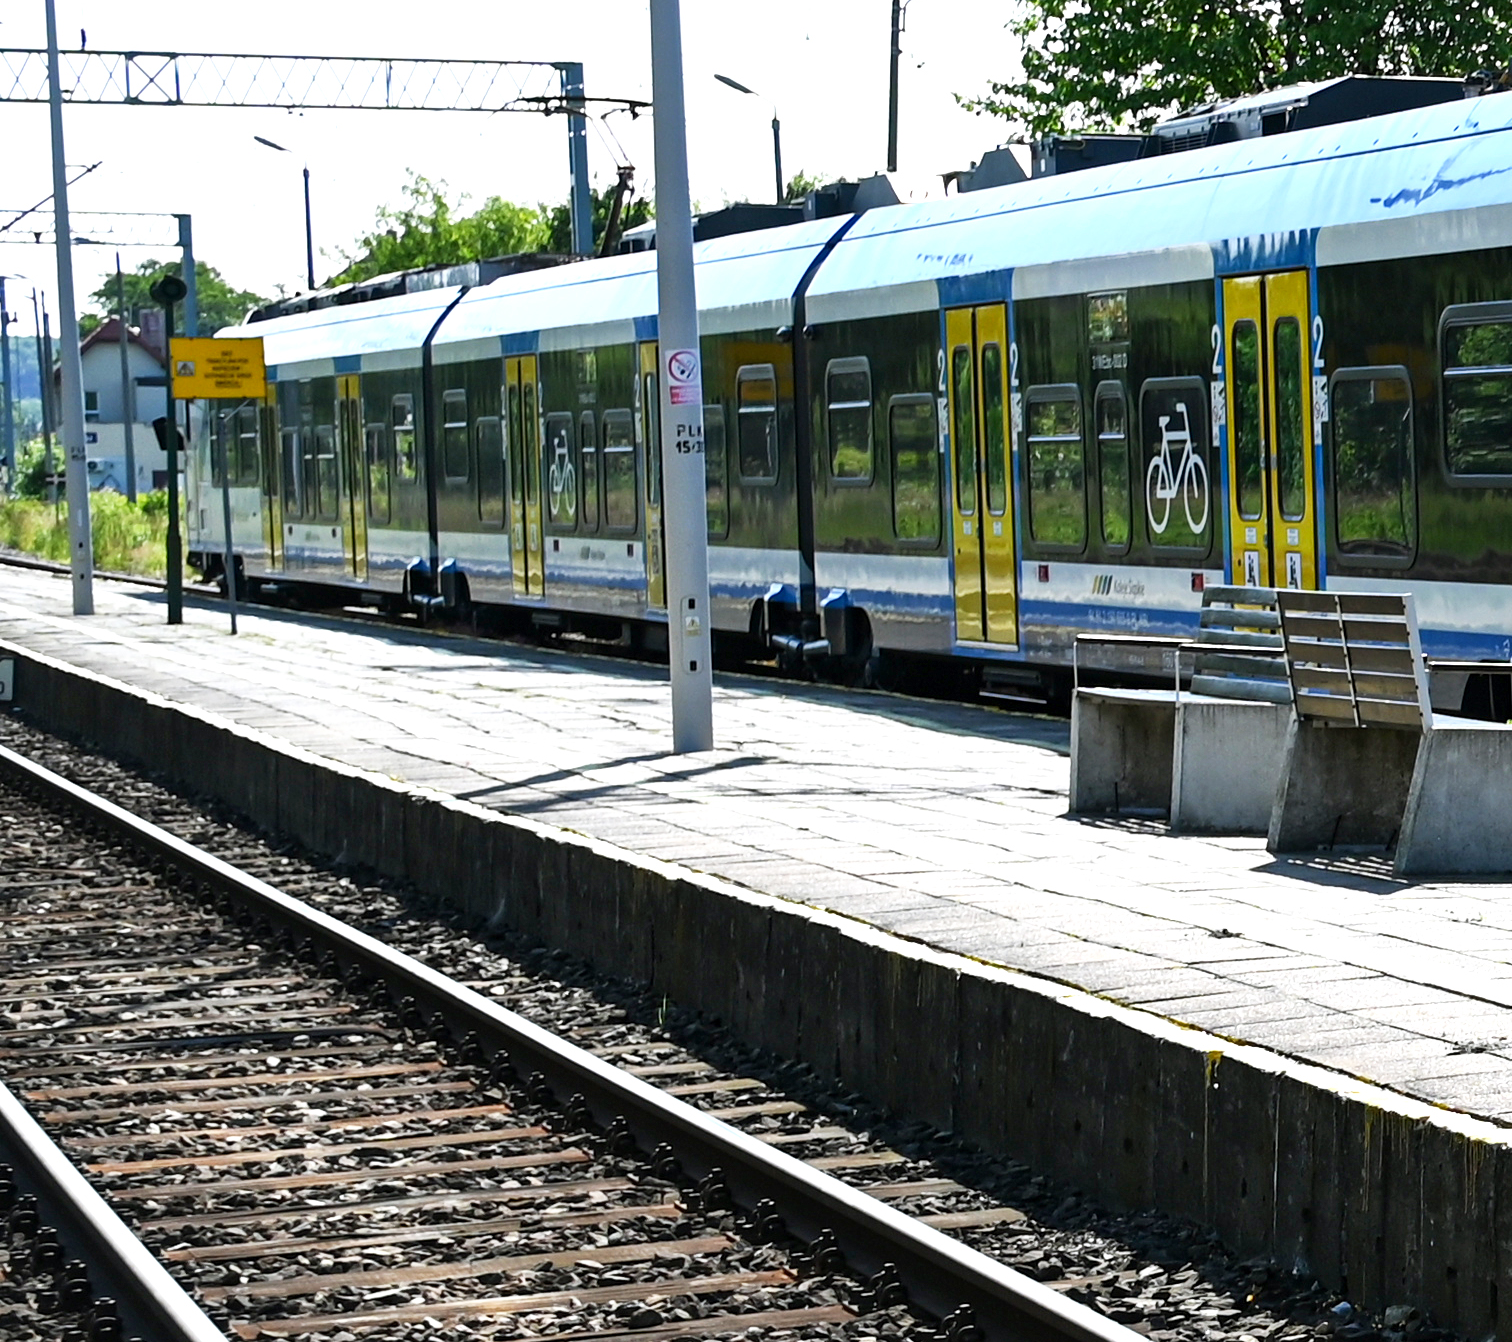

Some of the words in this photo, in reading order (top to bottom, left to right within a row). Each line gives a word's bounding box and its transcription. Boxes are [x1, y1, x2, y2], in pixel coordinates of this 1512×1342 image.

[1009, 342, 1019, 386] 2
[1212, 324, 1222, 374] 2
[1313, 315, 1325, 368] 2
[937, 348, 946, 391] 2
